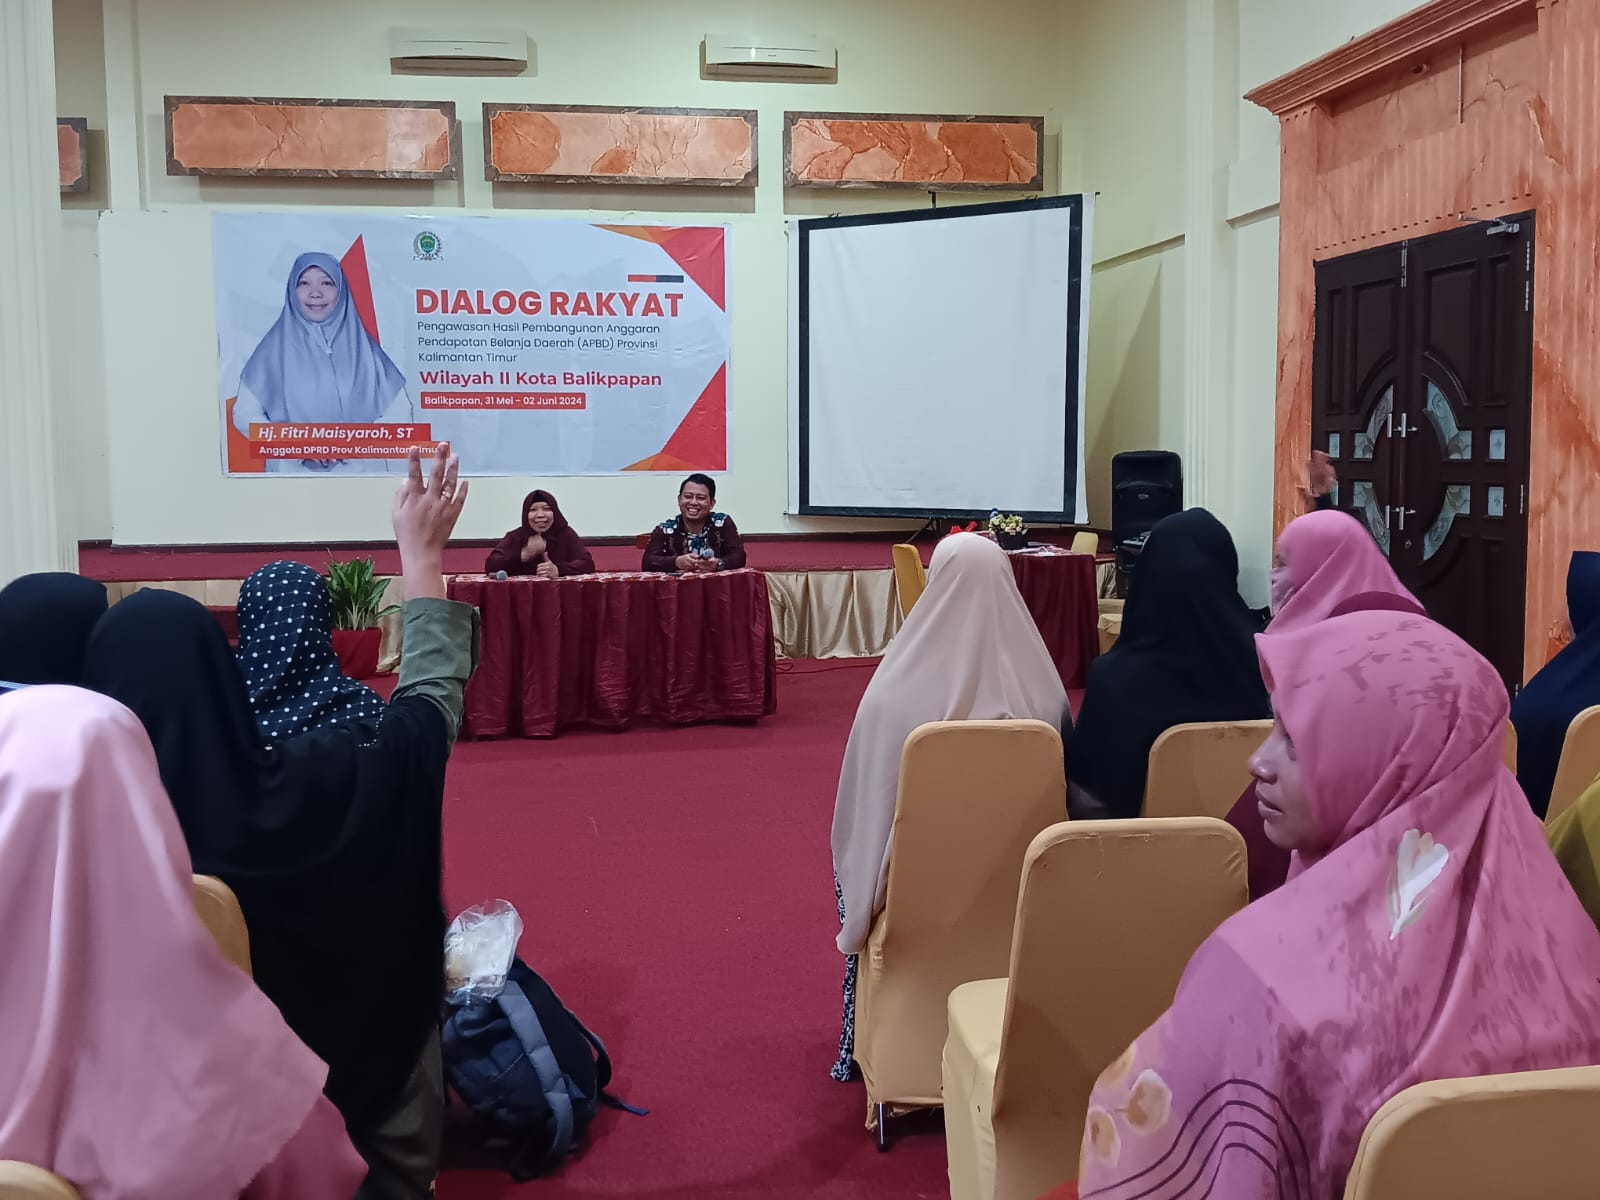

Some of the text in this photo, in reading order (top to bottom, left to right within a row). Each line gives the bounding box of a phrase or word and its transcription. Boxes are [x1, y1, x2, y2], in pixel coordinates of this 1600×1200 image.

[416, 289, 684, 317] DIALOG RAKYAT
[417, 321, 660, 336] Pengawasan Hasil Pembangunan Anggaran
[418, 336, 658, 350] Pendapatan Belanja Daerah (APBD) Provinsi
[418, 352, 518, 363] Kalimantan Timur
[420, 370, 662, 388] Wilayah II Kota Balikpapan
[424, 396, 483, 407] Balikpapan,
[485, 397, 494, 405] 31
[496, 397, 514, 405] Mei
[523, 397, 535, 405] 02
[537, 397, 558, 405] Juni
[559, 397, 582, 405] 2024
[259, 426, 414, 442] Hj. Fitri Maisyaroh, ST
[259, 446, 302, 456] Anggota
[303, 446, 329, 454] DPRD
[331, 446, 353, 454] Prov
[354, 445, 411, 454] Kalimantan
